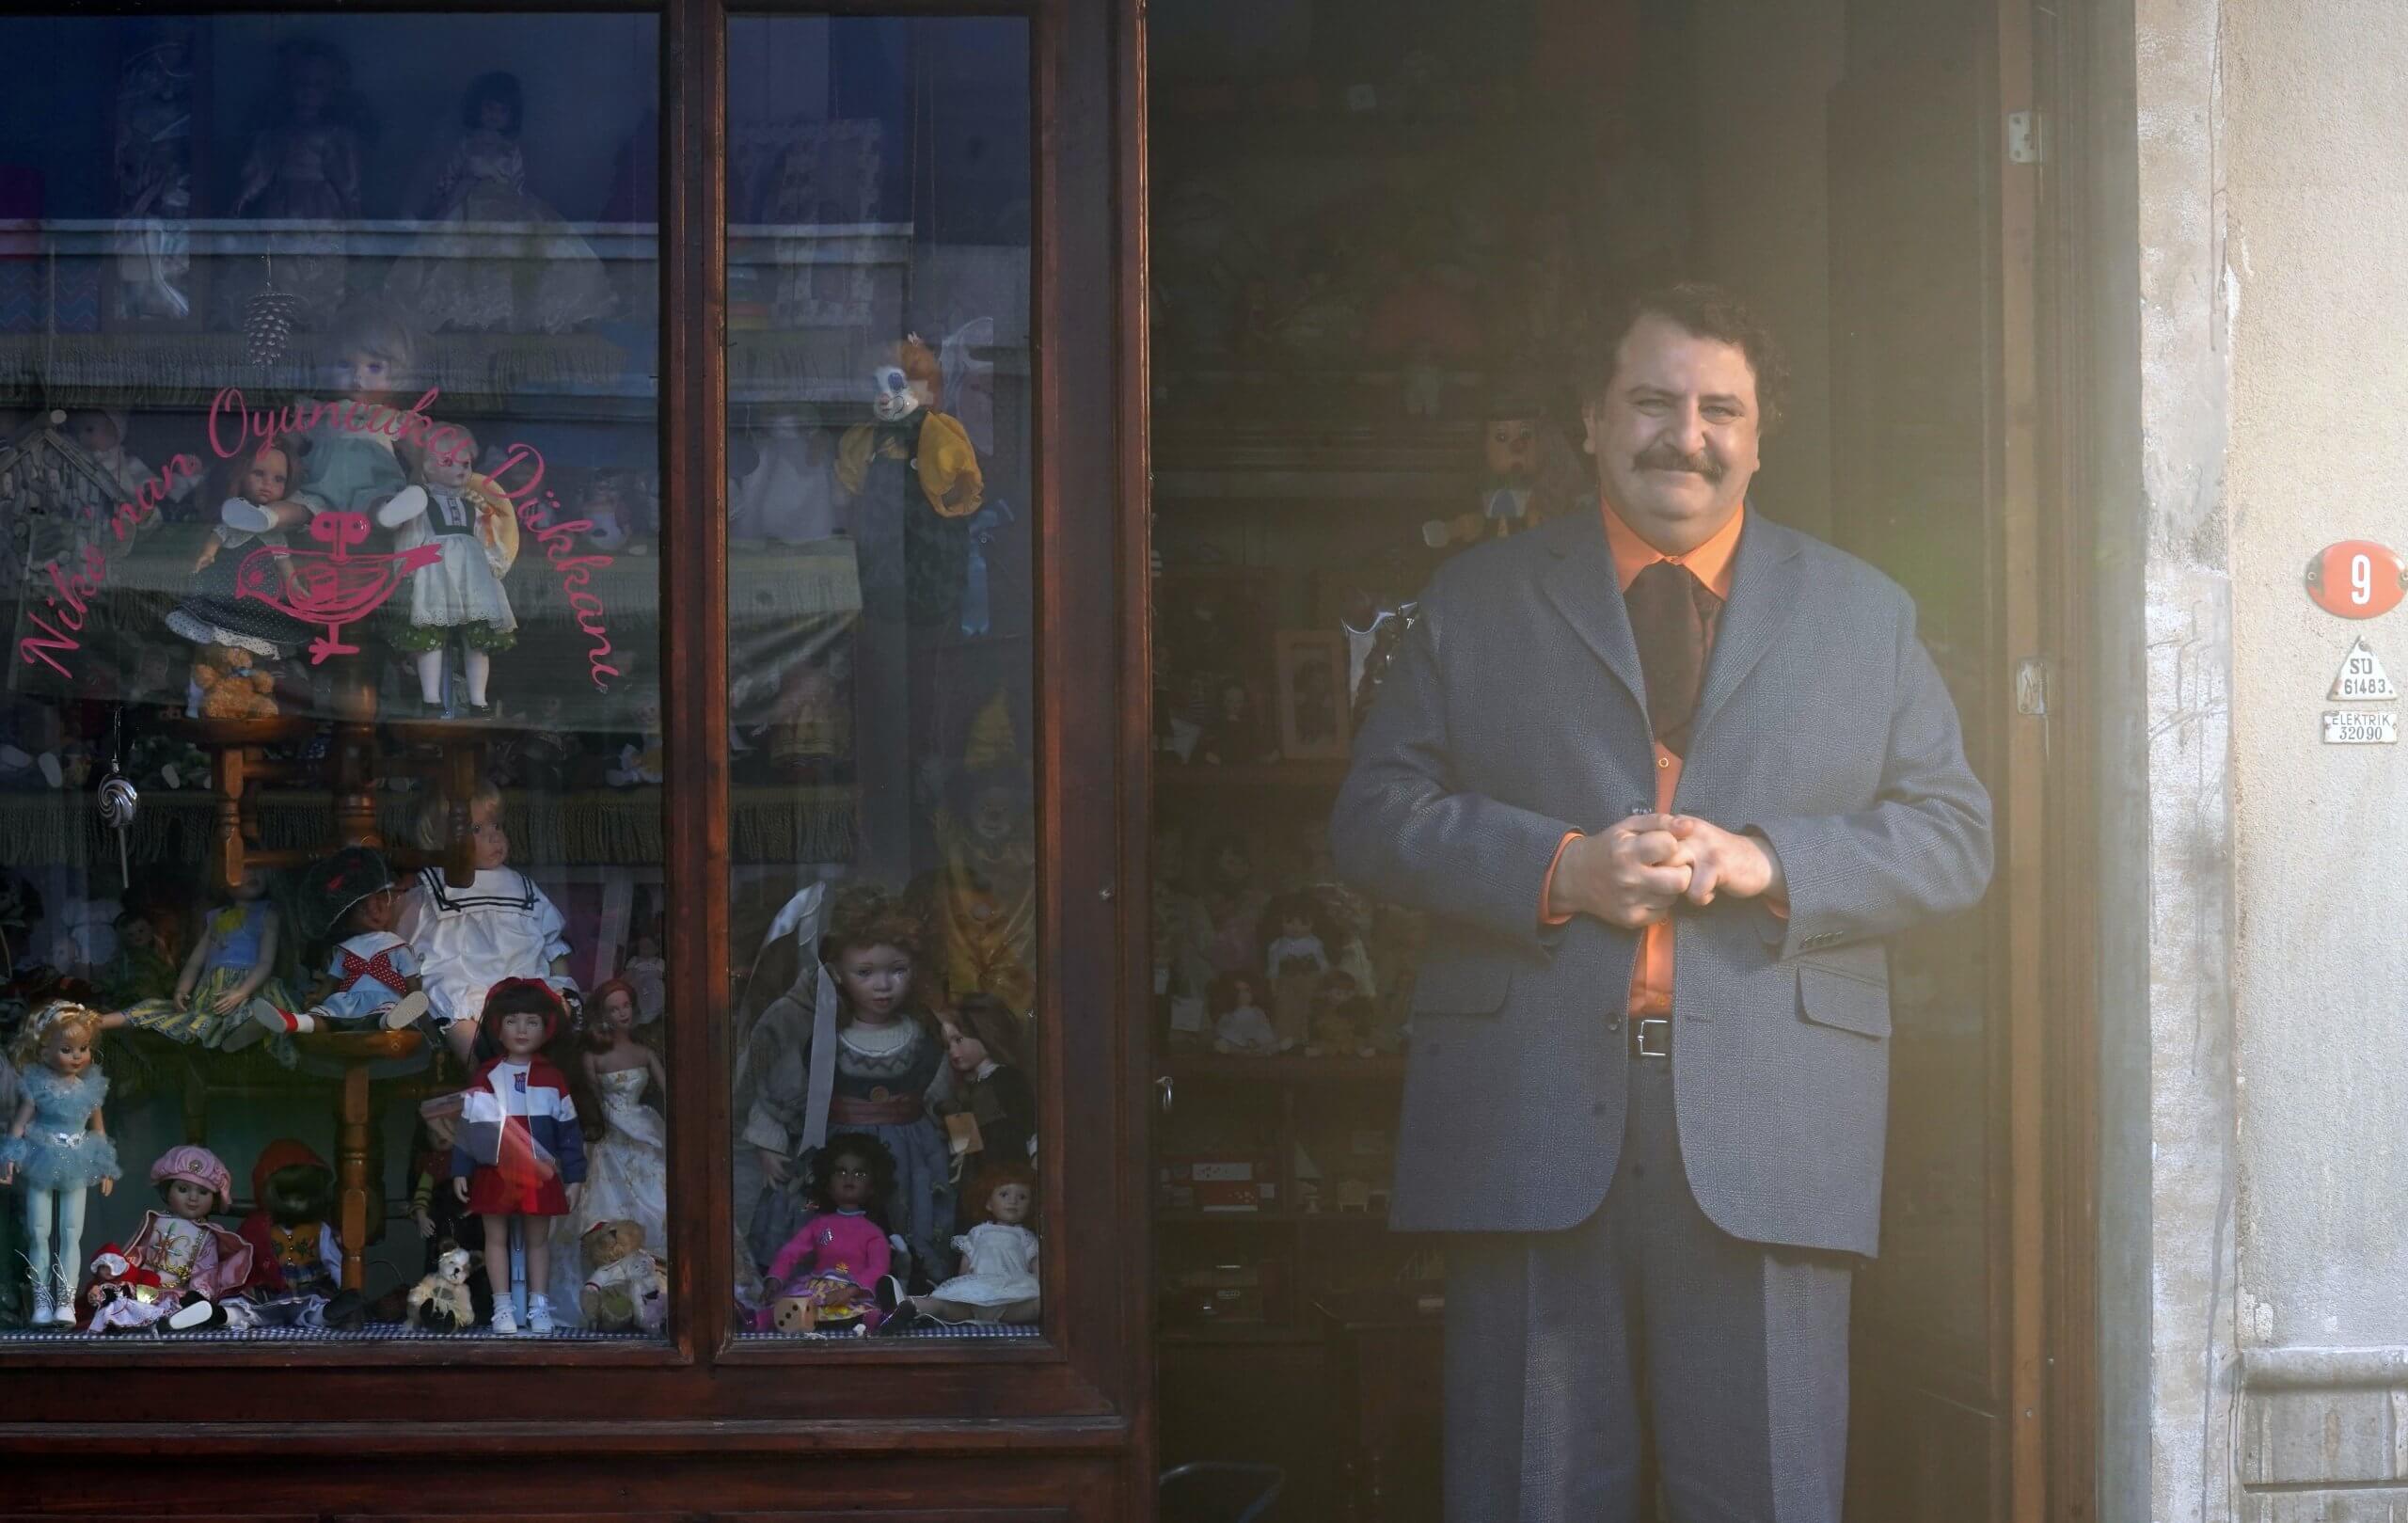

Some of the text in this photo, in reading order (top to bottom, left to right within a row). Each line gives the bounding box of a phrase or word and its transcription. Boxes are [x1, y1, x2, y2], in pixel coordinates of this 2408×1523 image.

[2351, 553, 2371, 605] 9
[2350, 658, 2373, 674] SU
[2344, 678, 2386, 695] 61483
[2339, 727, 2383, 740] 32090
